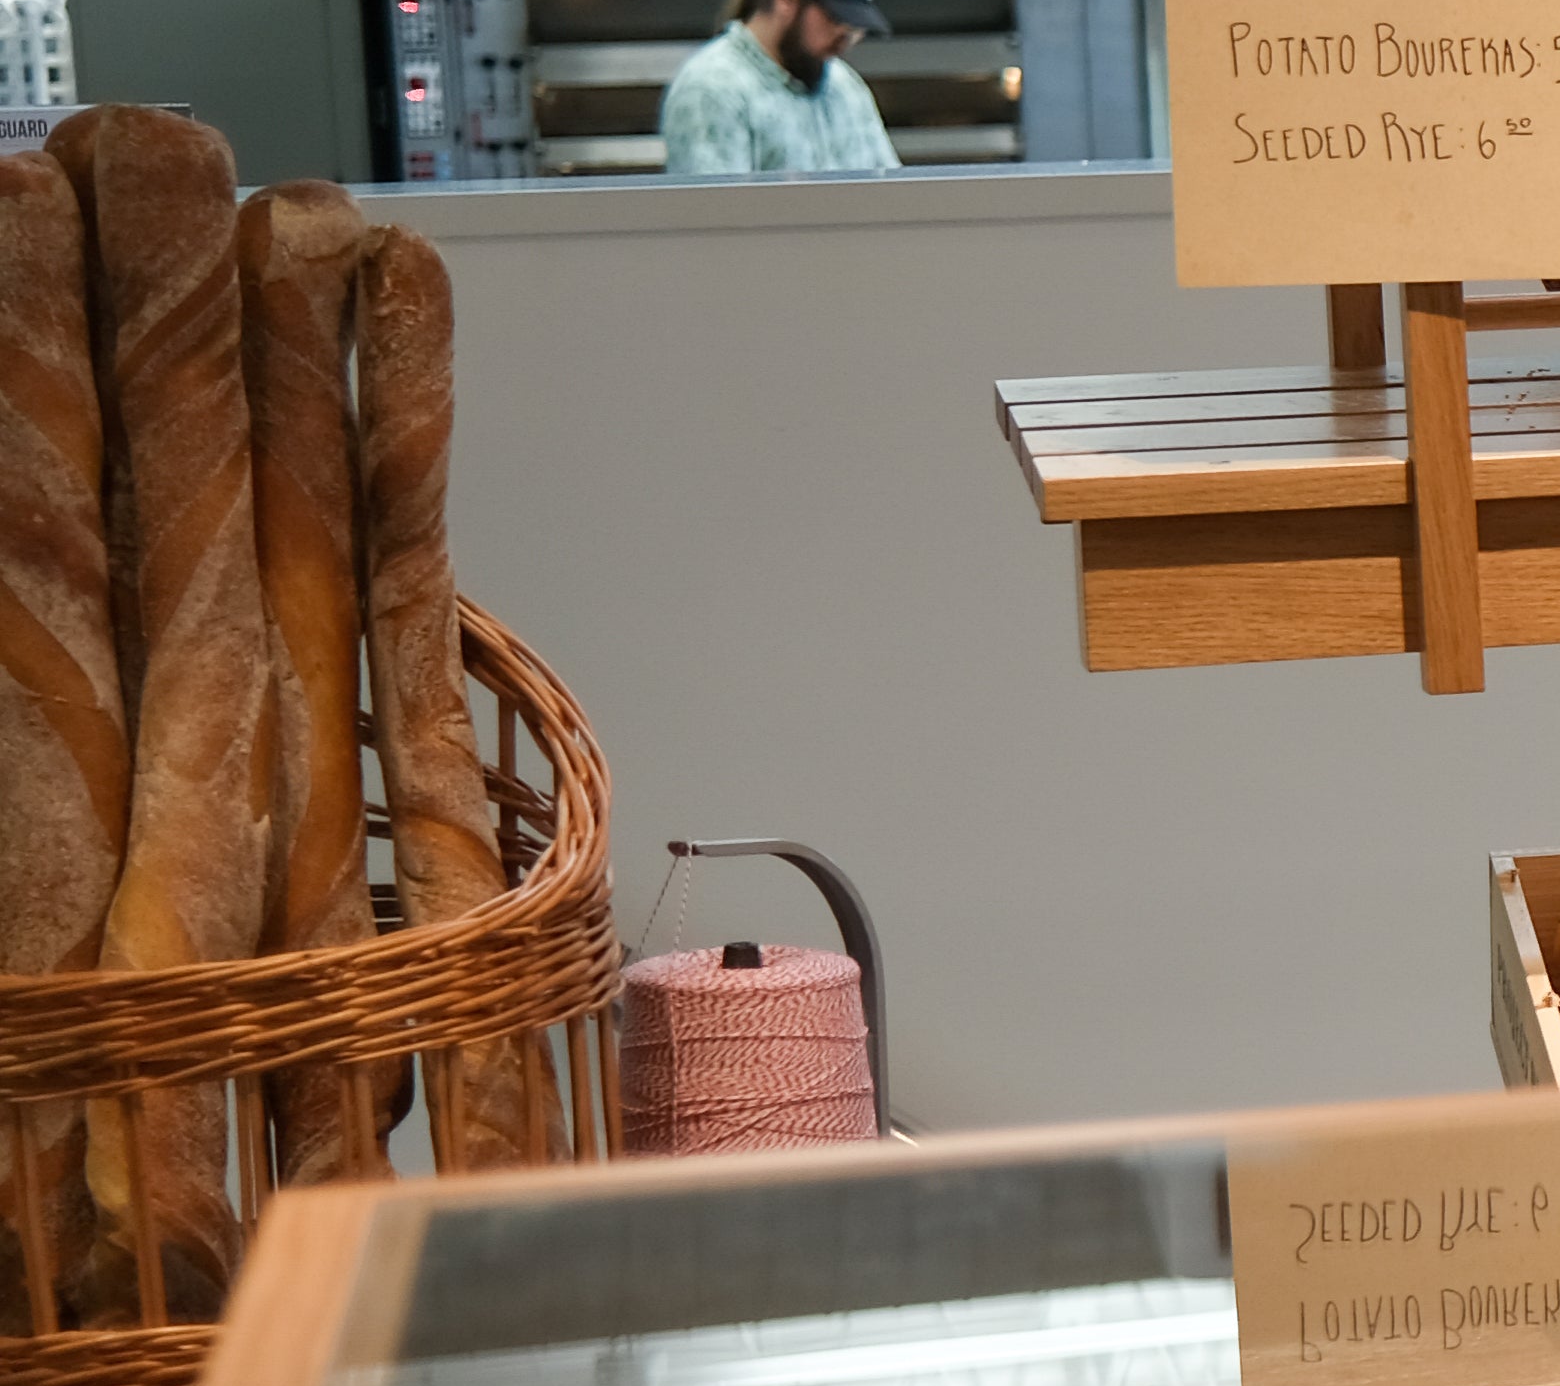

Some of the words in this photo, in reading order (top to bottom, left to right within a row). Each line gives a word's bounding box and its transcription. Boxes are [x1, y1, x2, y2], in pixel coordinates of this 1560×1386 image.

[1228, 21, 1356, 79] POTATO
[1373, 21, 1542, 79] BOUREKAS:
[1232, 112, 1367, 165] SEEDED
[1380, 111, 1465, 163] RYE:
